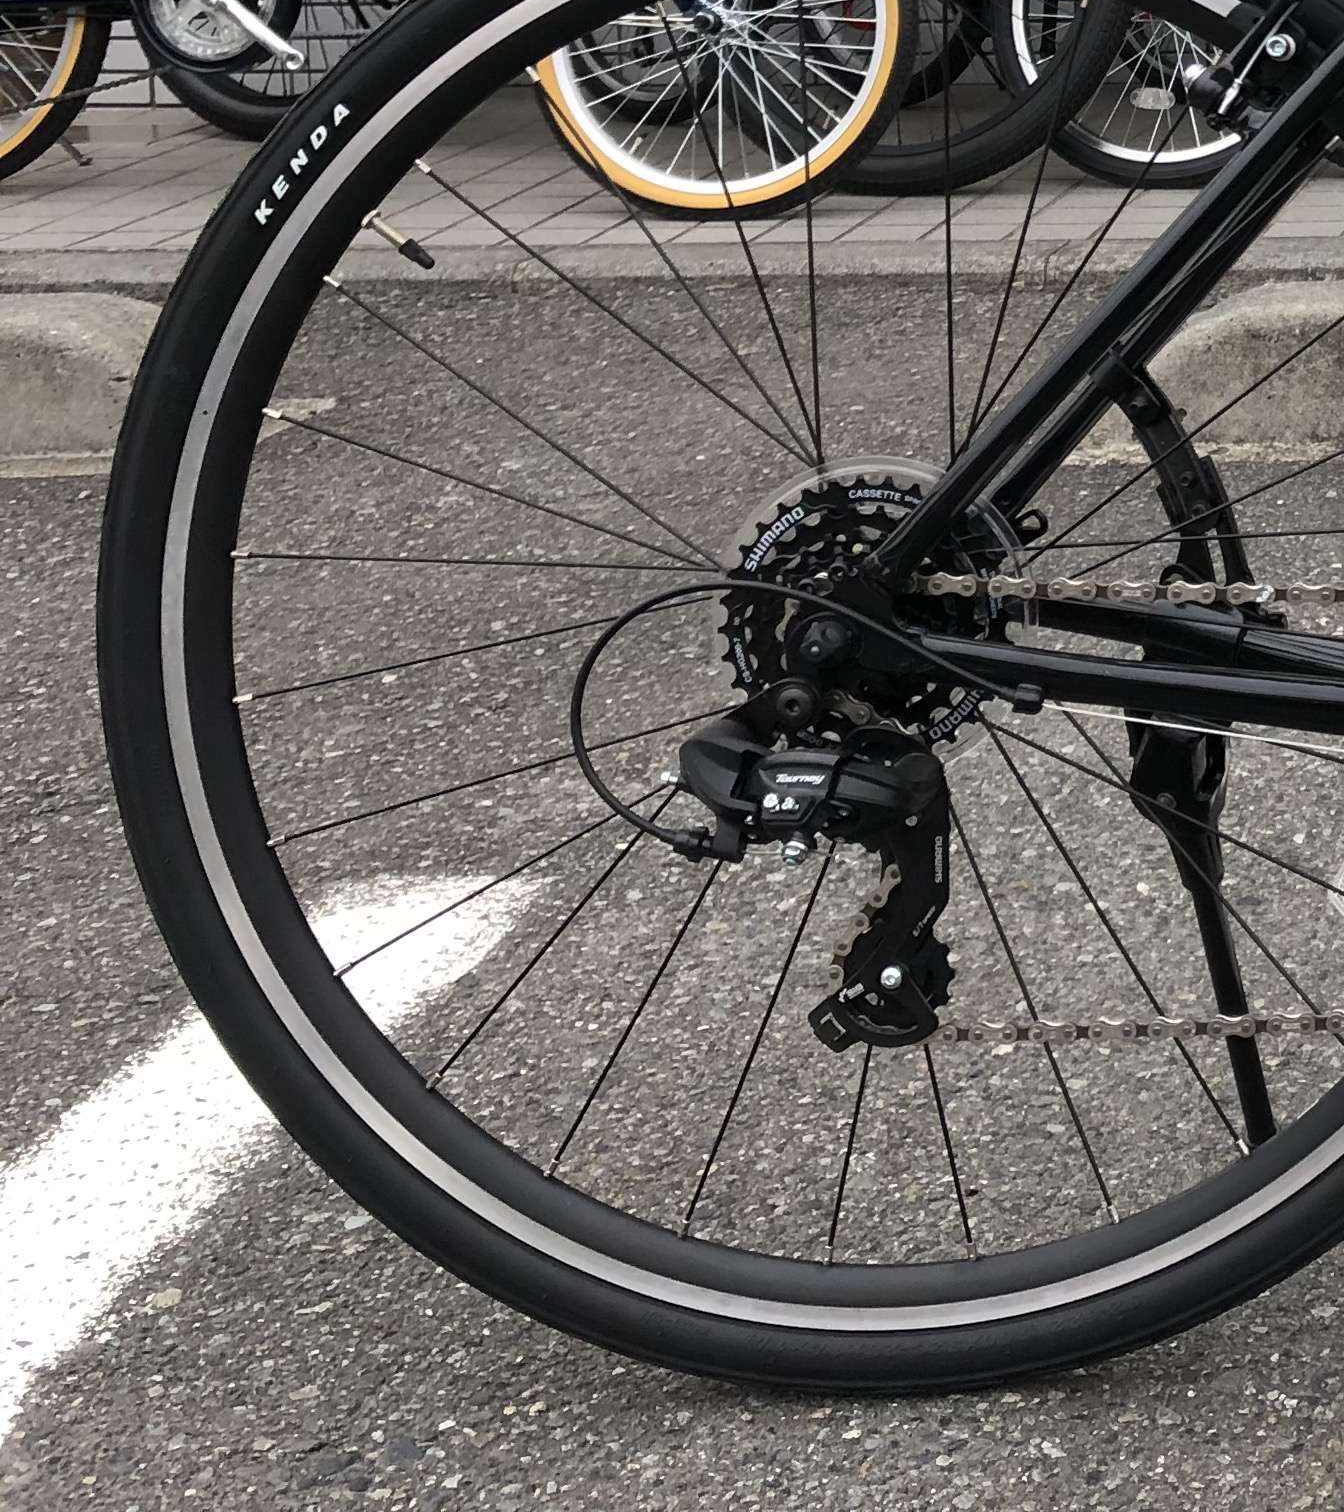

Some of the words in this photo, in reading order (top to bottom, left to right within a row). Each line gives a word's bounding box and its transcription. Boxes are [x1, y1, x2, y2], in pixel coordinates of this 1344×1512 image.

[254, 103, 351, 226] KENDA
[848, 489, 902, 502] CASSETTE
[744, 505, 805, 573] SHIMANO
[775, 773, 826, 786] Tourney
